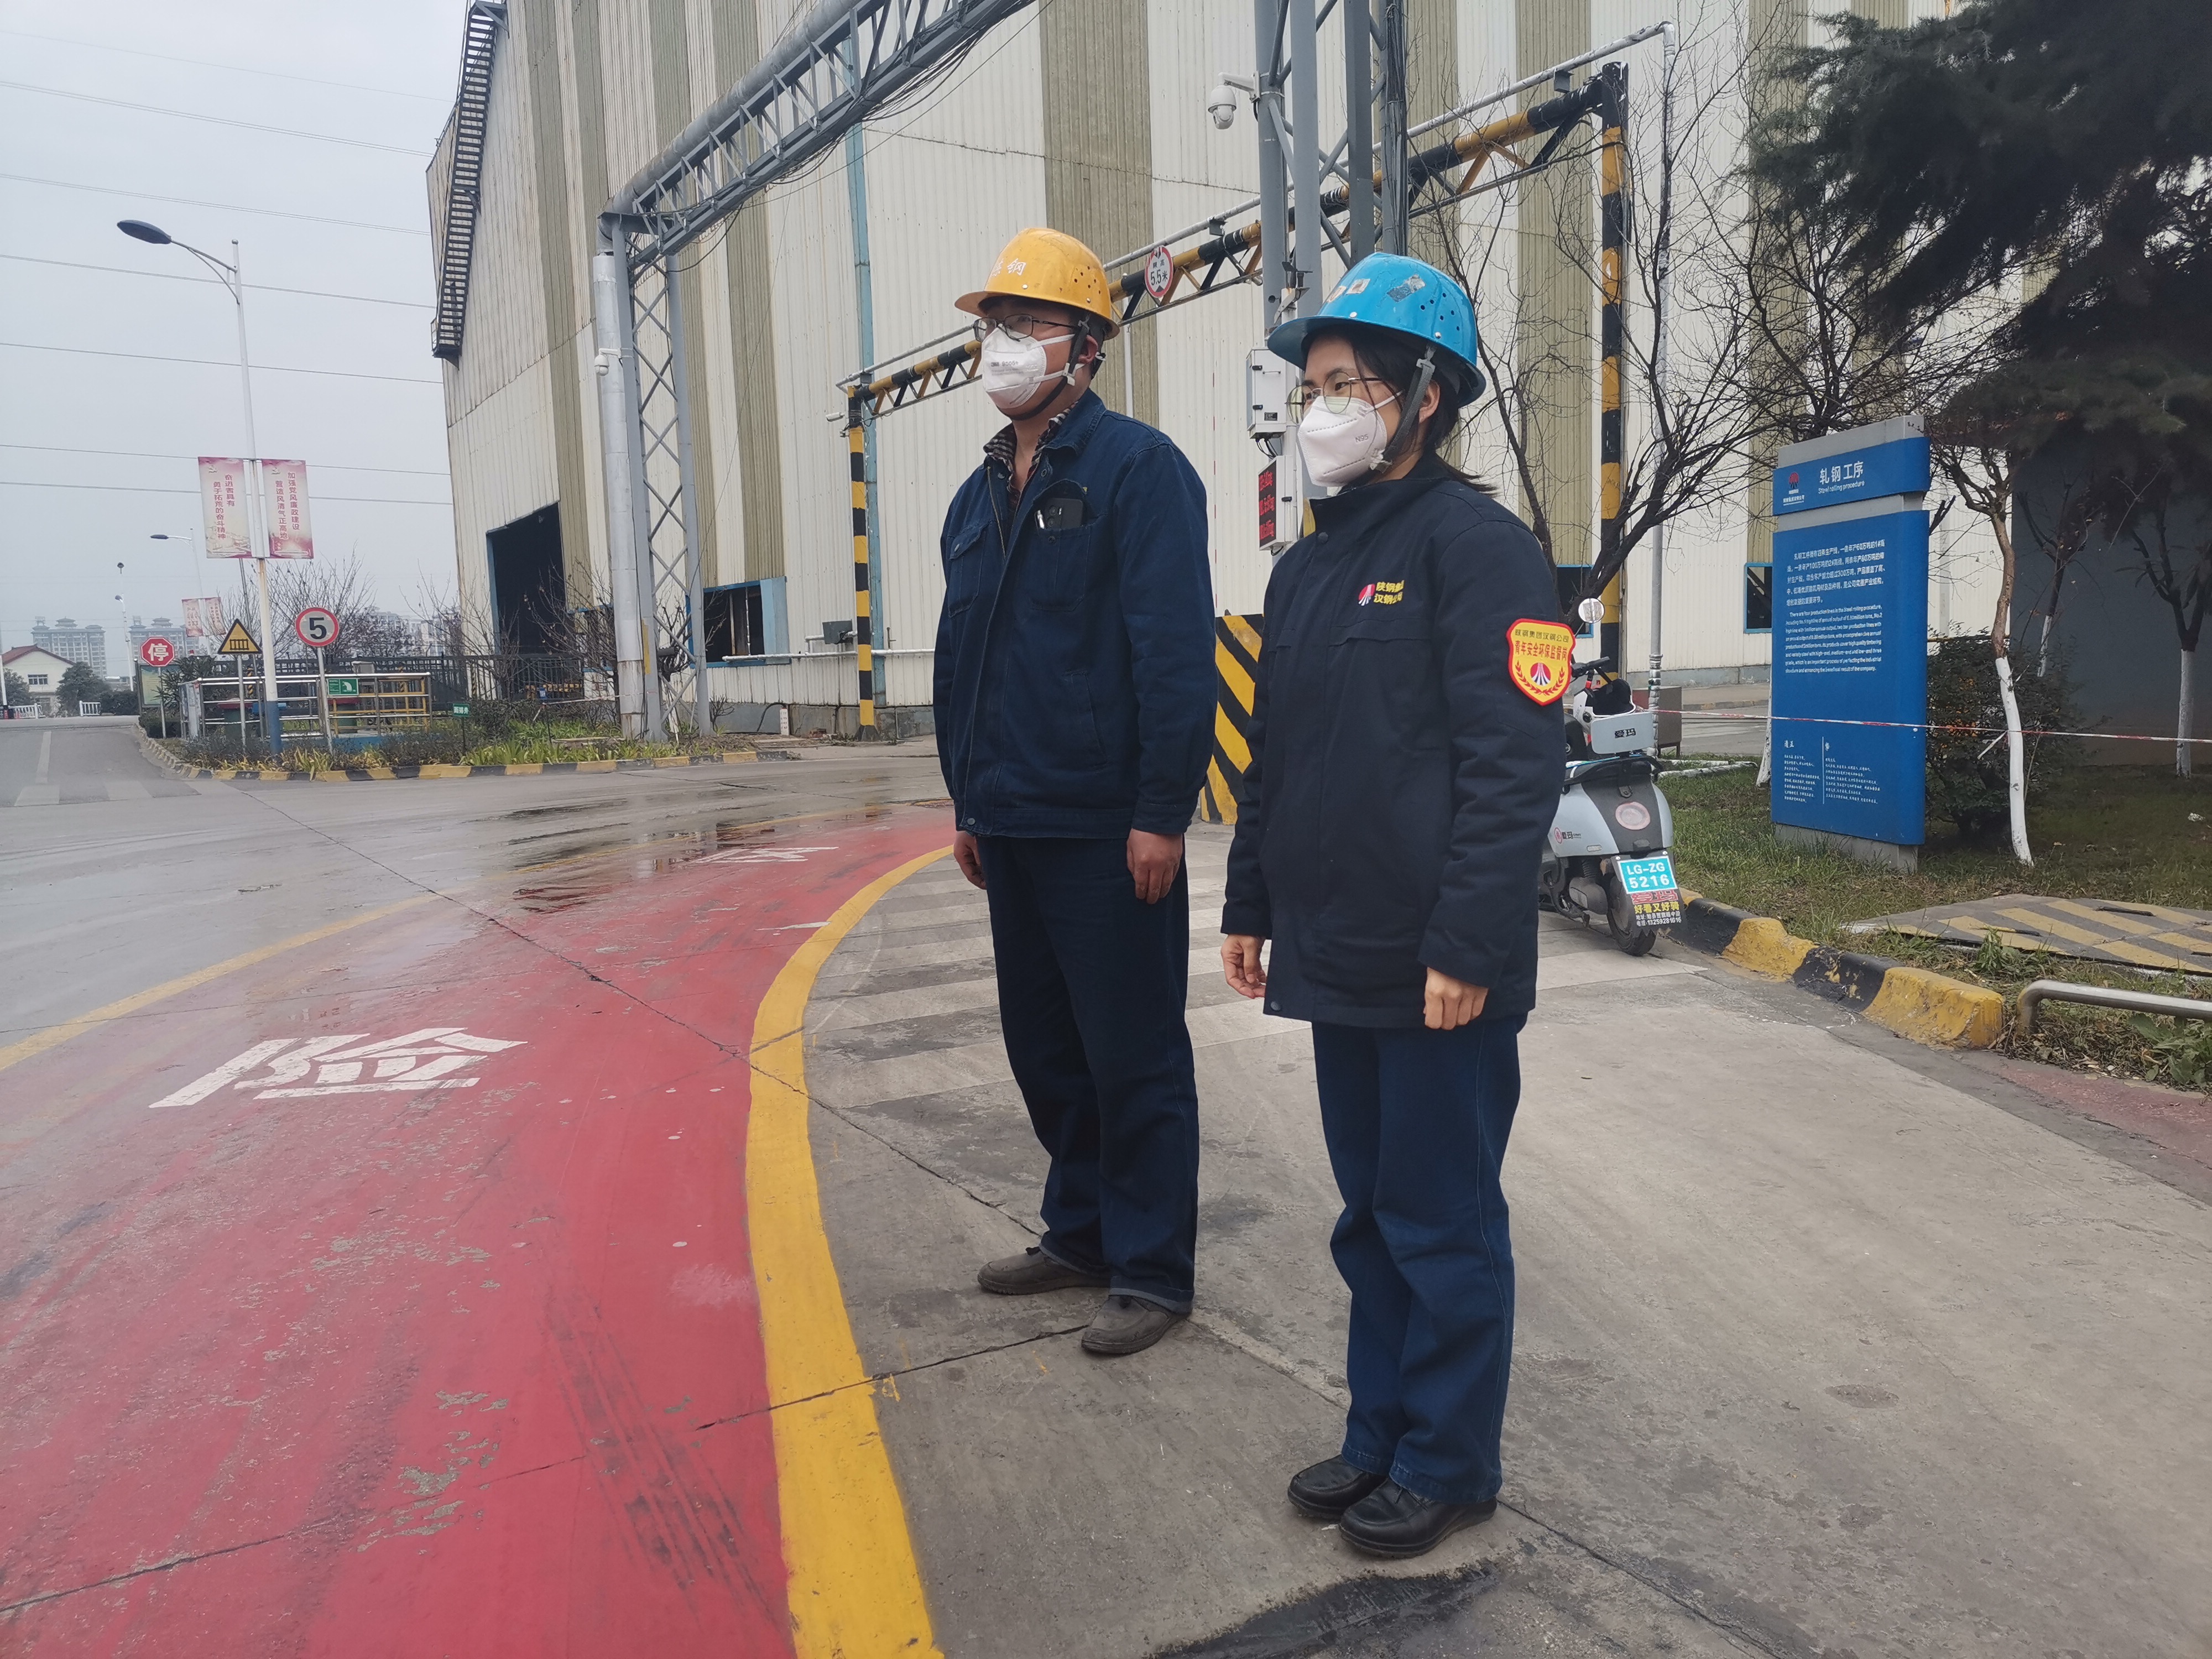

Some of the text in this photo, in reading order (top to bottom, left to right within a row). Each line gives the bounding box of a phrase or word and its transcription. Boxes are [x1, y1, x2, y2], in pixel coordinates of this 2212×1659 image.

[1150, 269, 1168, 285] 5.5米
[1355, 434, 1369, 442] N95
[1819, 461, 1864, 485] 轧钢工序
[1829, 484, 1842, 492] rolling
[1843, 480, 1865, 491] procedure
[288, 472, 300, 530] 加强党风廉政建设
[309, 617, 327, 639] 5
[1515, 629, 1569, 643] 陕钢集团汉钢公司
[148, 643, 169, 661] 停
[1515, 640, 1567, 661] 青年安全环保监督岗
[1615, 728, 1636, 738] 爱玛
[1626, 862, 1665, 875] LG-ZG
[1629, 874, 1670, 889] 5216
[1634, 901, 1679, 914] 好看又好骑
